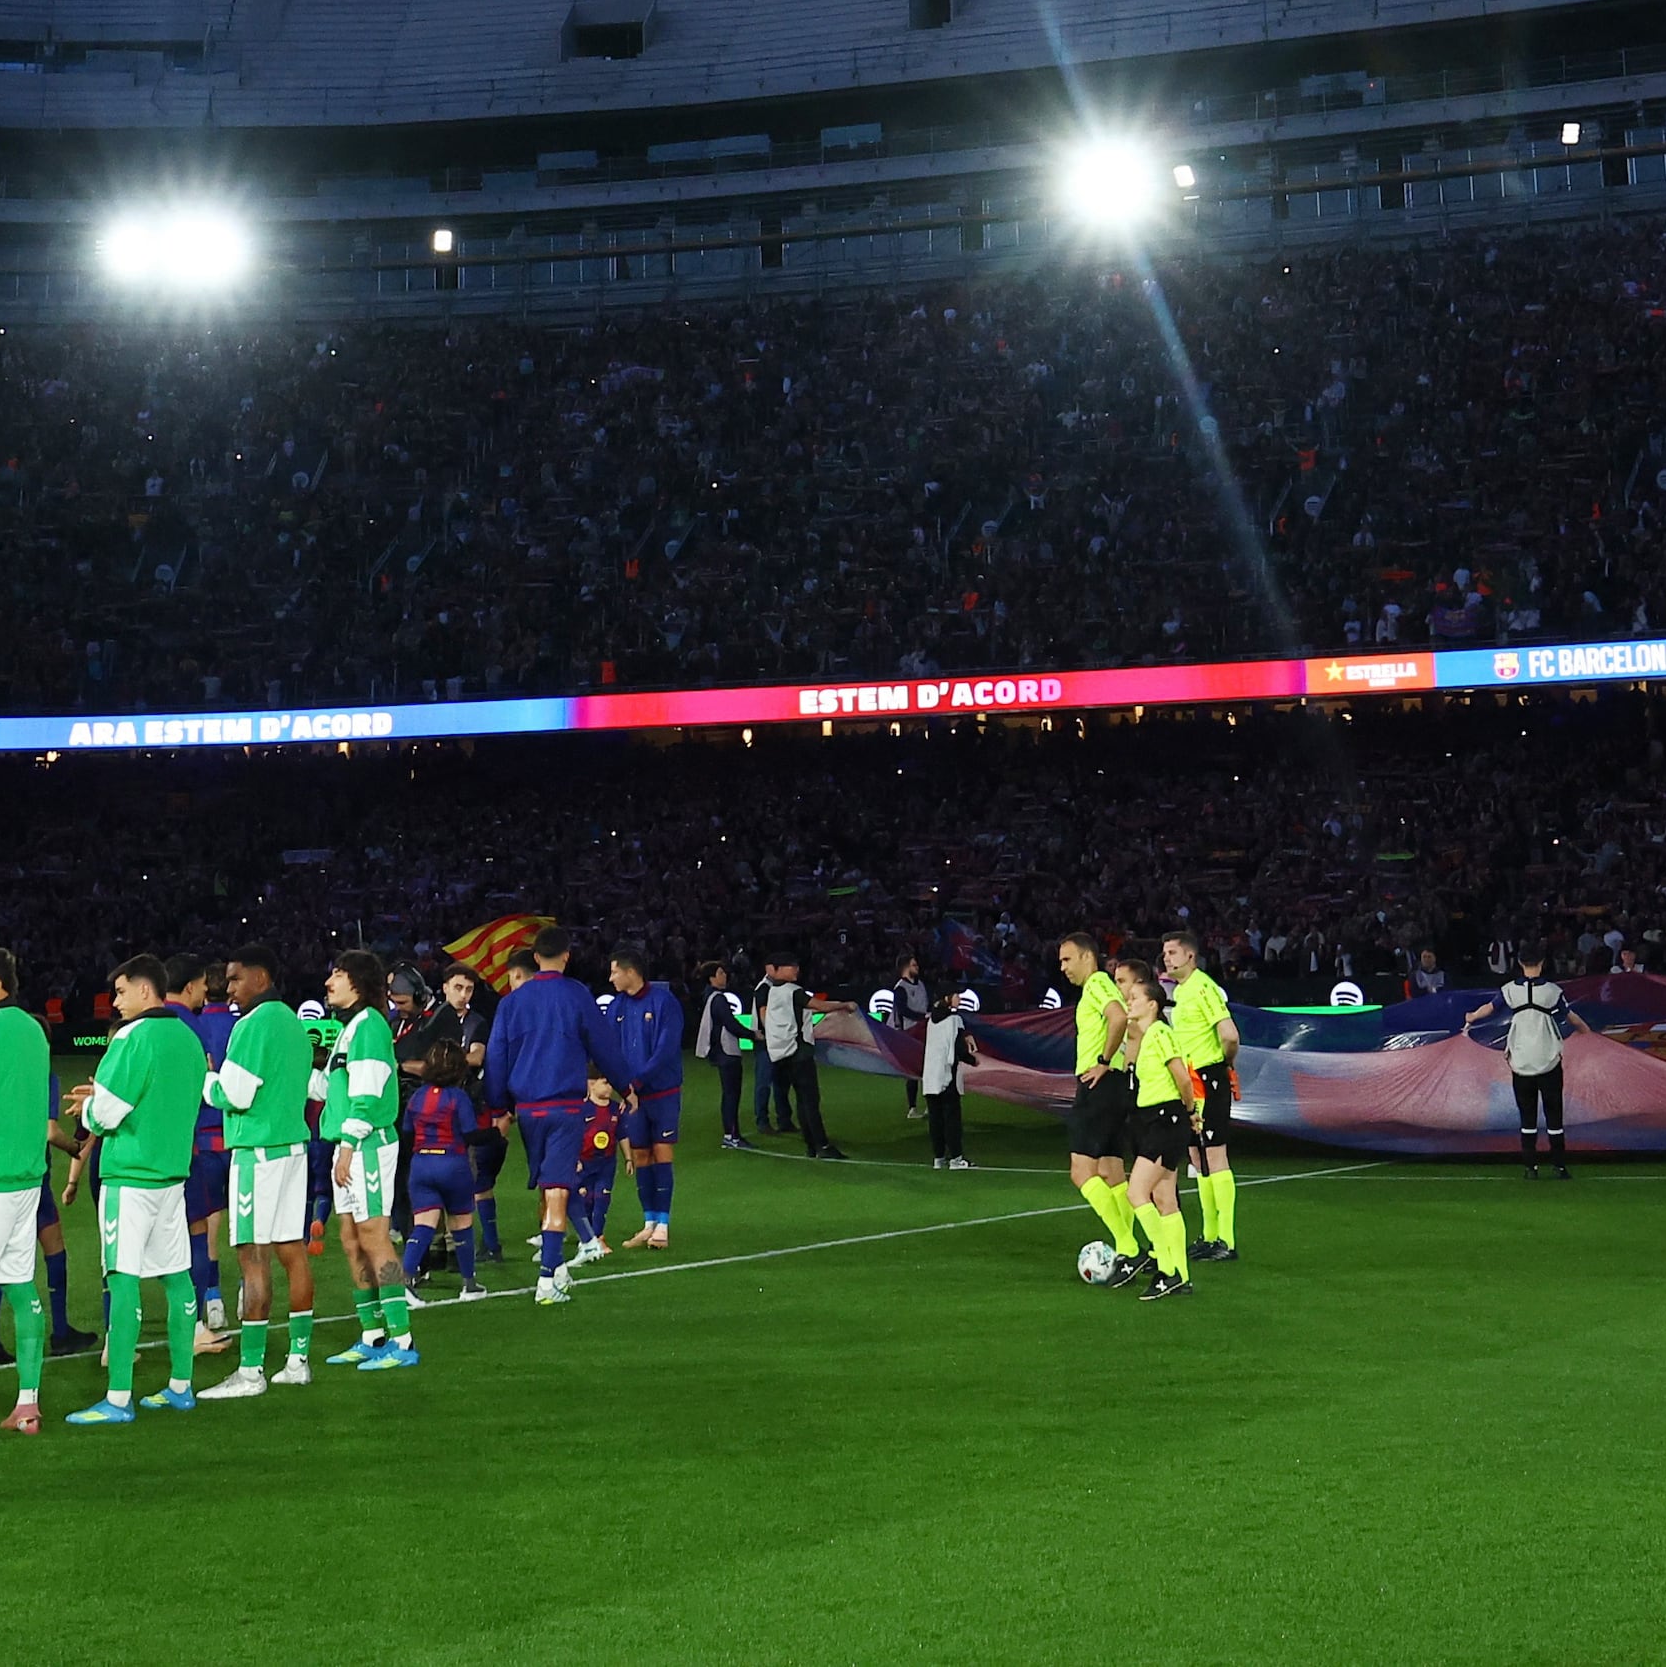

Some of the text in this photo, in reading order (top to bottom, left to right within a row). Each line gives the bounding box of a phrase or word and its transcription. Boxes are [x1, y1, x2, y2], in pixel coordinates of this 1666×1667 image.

[1528, 651, 1556, 678] FC
[799, 685, 909, 714] ESTEM
[69, 721, 138, 746] ARA
[145, 718, 252, 744] ESTEM
